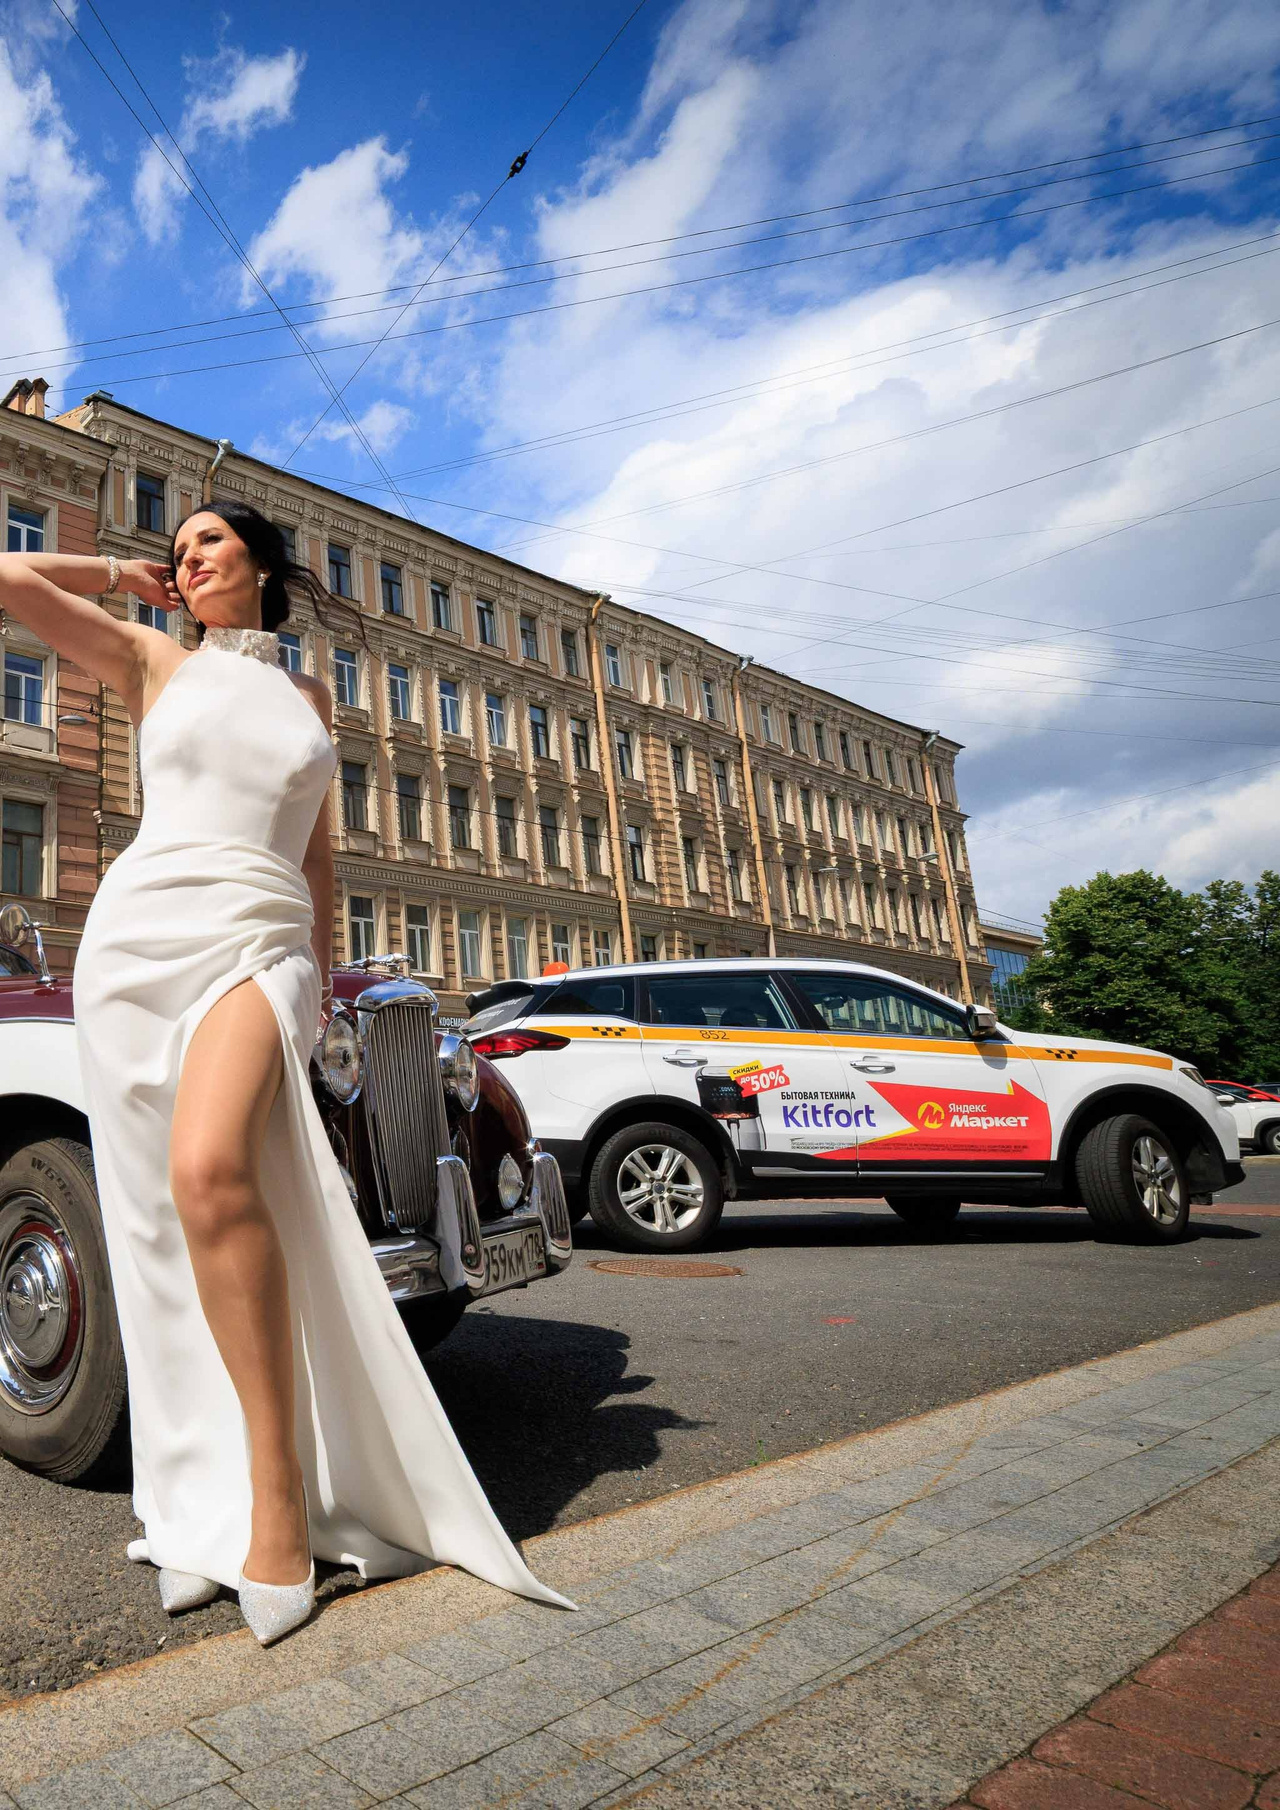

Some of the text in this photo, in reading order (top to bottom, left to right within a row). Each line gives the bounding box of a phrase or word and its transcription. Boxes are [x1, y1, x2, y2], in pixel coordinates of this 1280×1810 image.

[699, 1029, 730, 1040] 852
[751, 1069, 786, 1092] 50%
[781, 1091, 856, 1101] БЫТОВАЯ ТЕХНИКА
[948, 1103, 987, 1113] Яндекс
[782, 1102, 877, 1129] Kitfort
[950, 1114, 1029, 1129] Маркет
